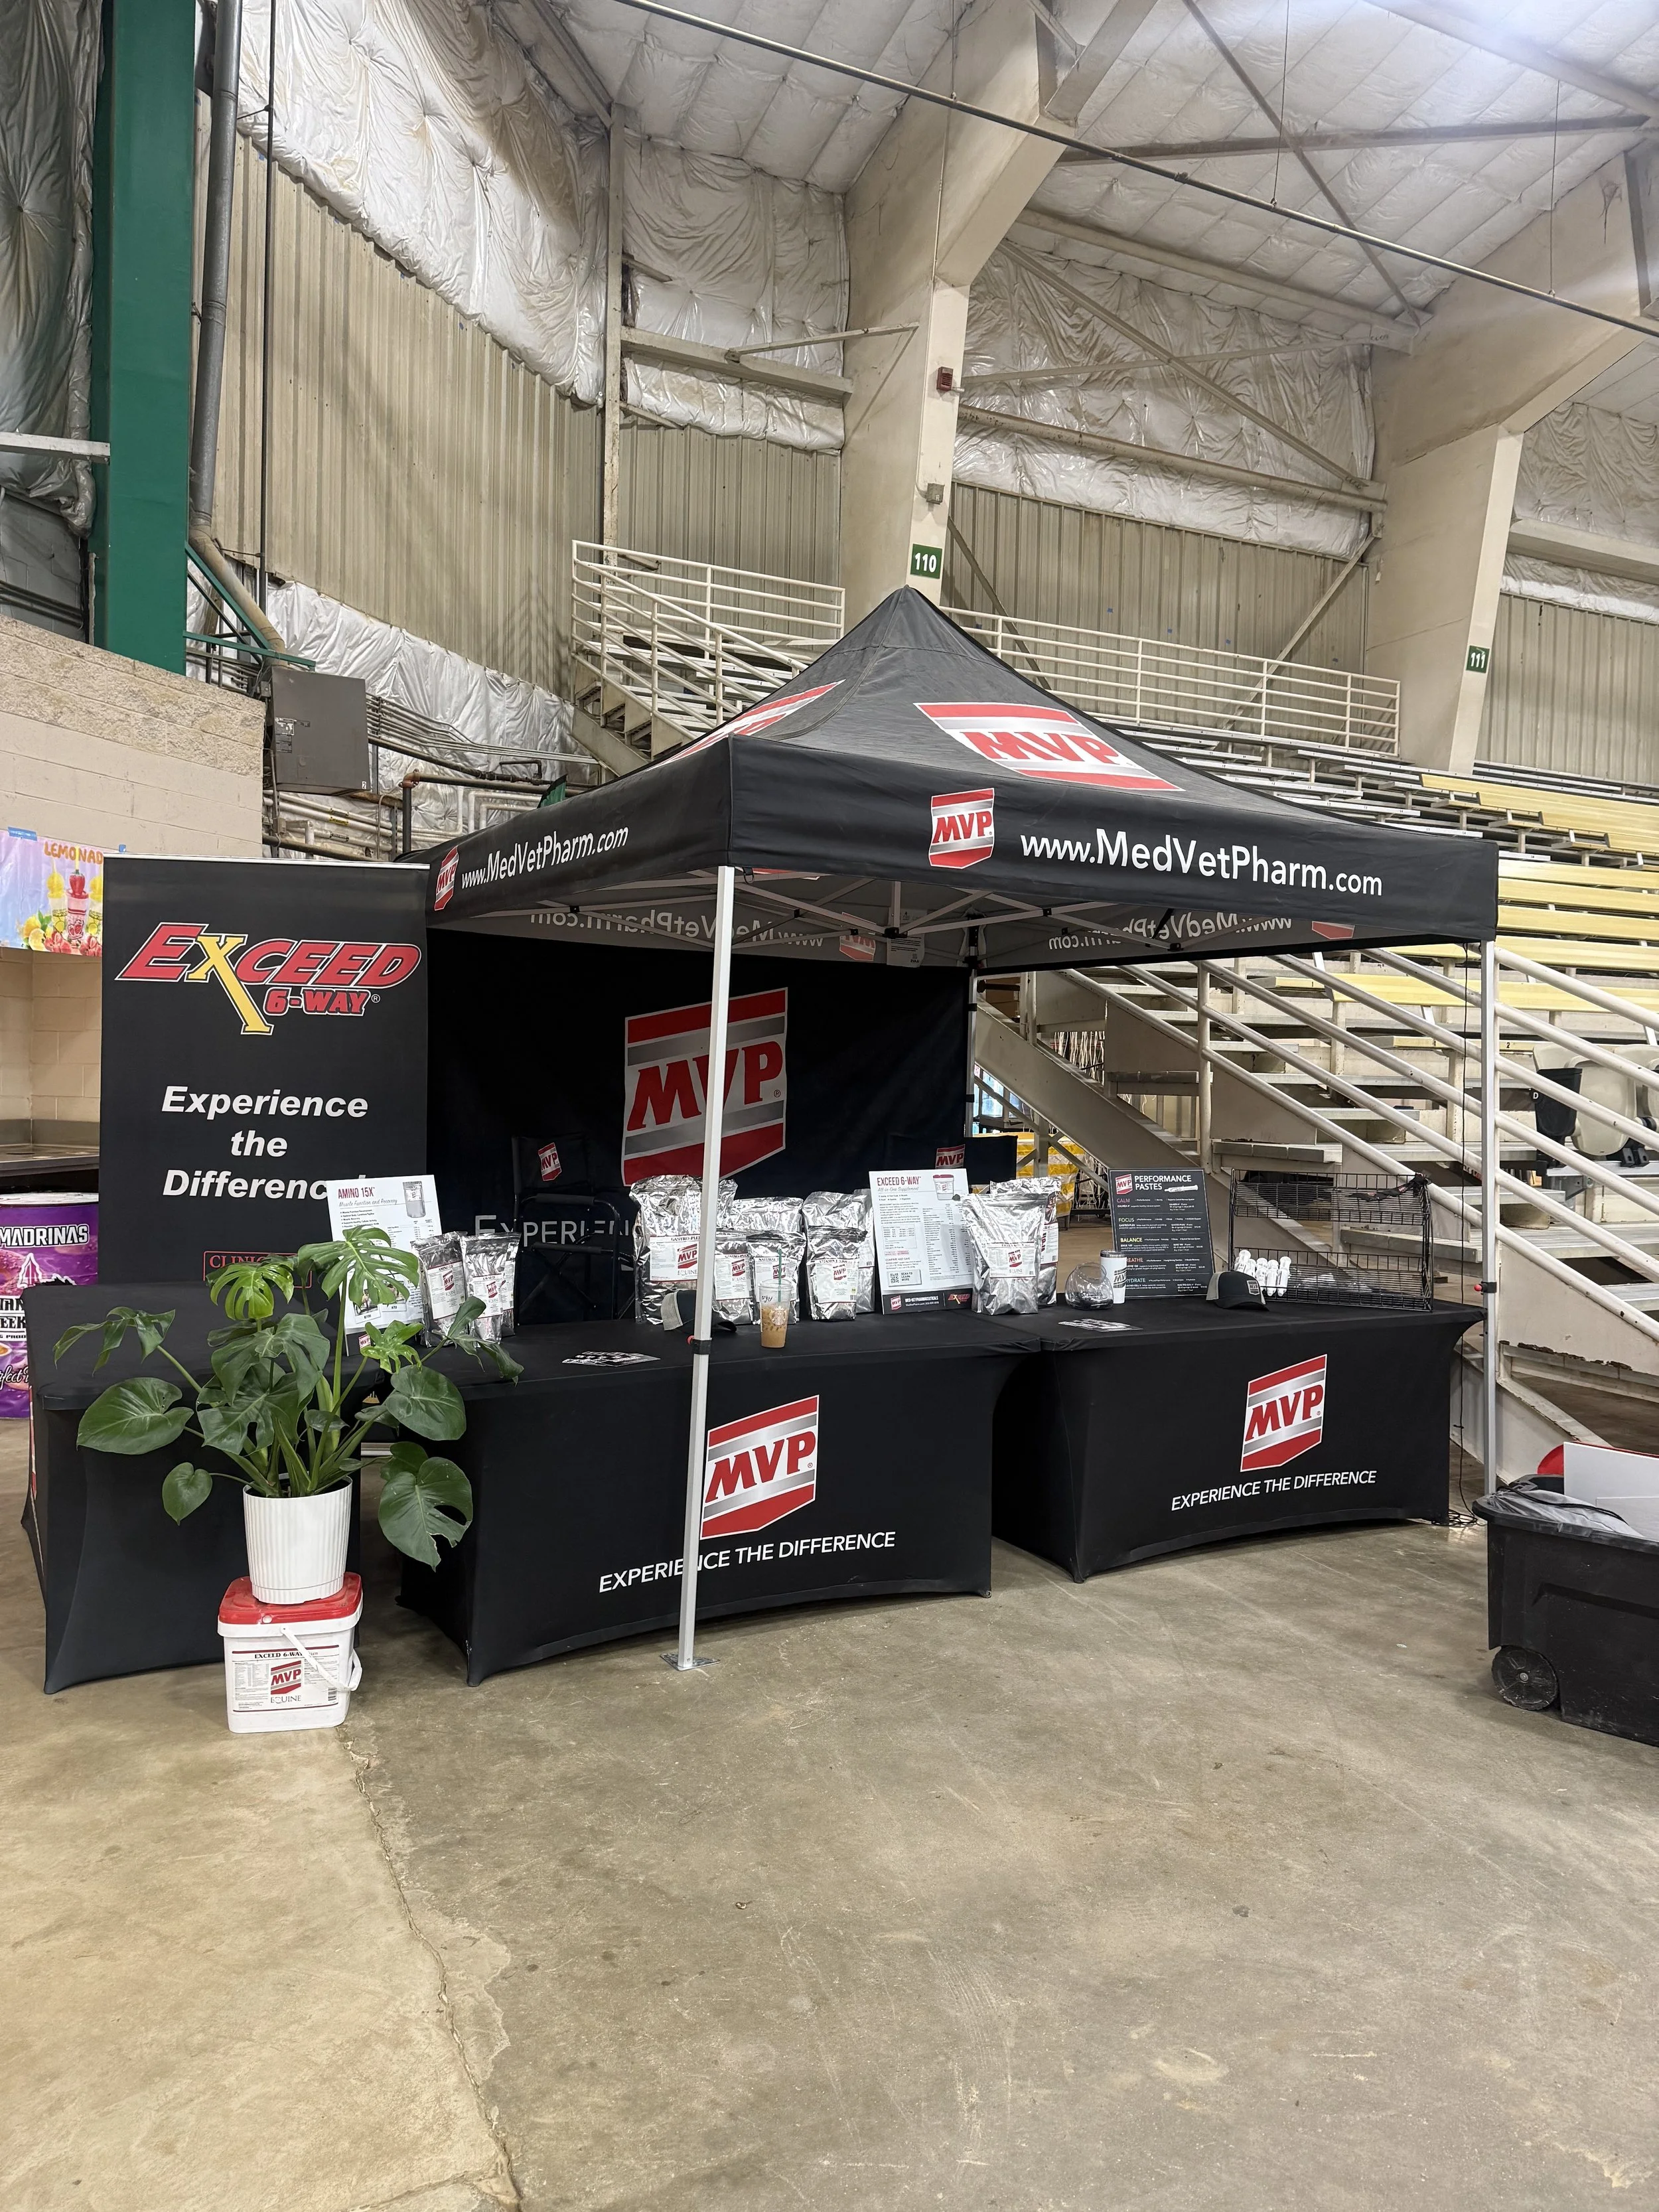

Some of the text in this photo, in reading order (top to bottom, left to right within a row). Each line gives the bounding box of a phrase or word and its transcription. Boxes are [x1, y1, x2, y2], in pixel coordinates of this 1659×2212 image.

[915, 552, 937, 573] 110
[1471, 652, 1486, 668] 111
[963, 731, 1120, 765] MVP
[933, 811, 992, 843] MVP
[462, 827, 628, 889] www.MedVetPharm.com
[1020, 828, 1383, 897] www.MedVetPharm.com
[436, 862, 457, 893] MVP
[114, 922, 421, 1035] EXCEED
[161, 1085, 369, 1120] Experience
[231, 1130, 288, 1157] the
[541, 1152, 558, 1171] MVP
[936, 1153, 964, 1166] MVP
[338, 1188, 359, 1199] AMINO
[877, 1177, 900, 1186] EXCEED
[1117, 1180, 1131, 1189] MVP
[678, 1250, 697, 1262] MVP
[732, 1263, 745, 1272] MVP
[444, 1276, 454, 1286] MVP
[1245, 1384, 1324, 1441] MVP
[705, 1431, 816, 1503] MVP
[1171, 1471, 1377, 1511] EXPERIENCE THE DIFFERENCE
[599, 1531, 896, 1593] EXPERIECE THE DIFFERENCE
[271, 1668, 301, 1686] MVP
